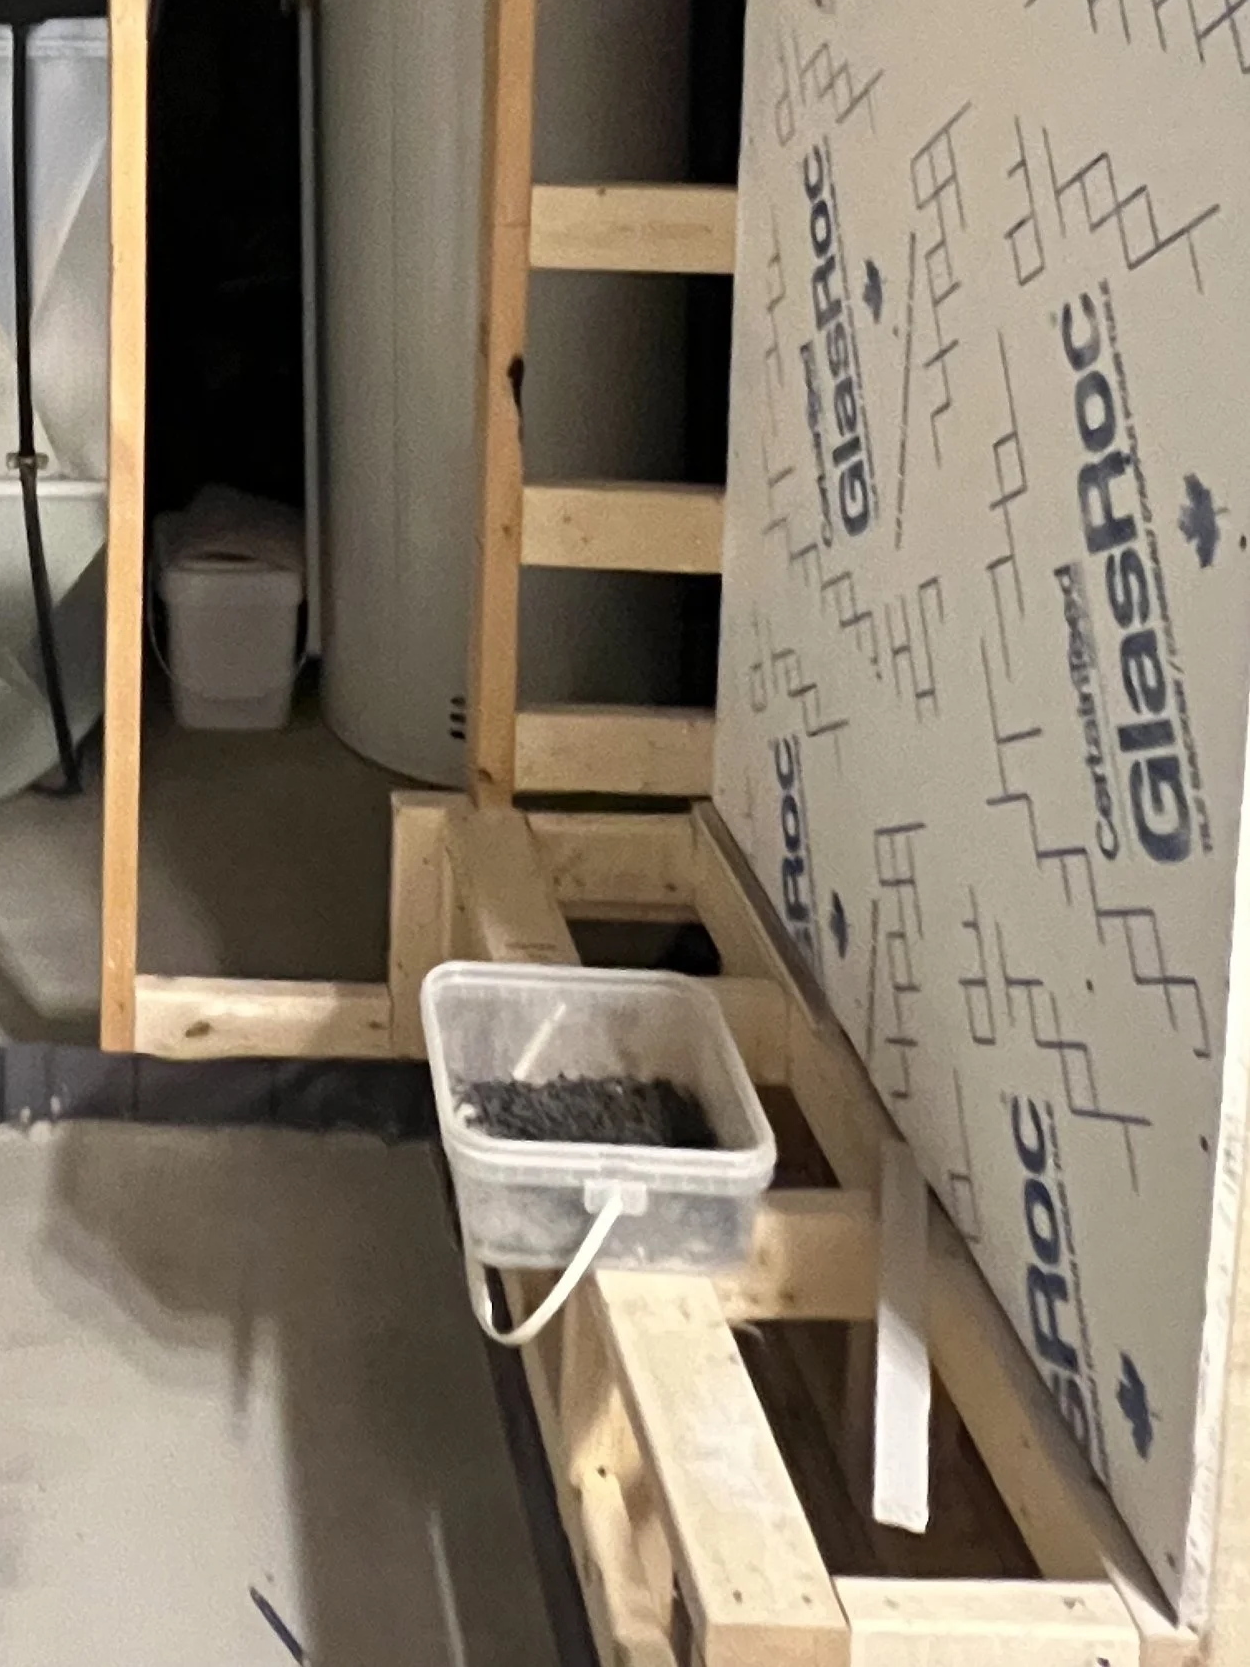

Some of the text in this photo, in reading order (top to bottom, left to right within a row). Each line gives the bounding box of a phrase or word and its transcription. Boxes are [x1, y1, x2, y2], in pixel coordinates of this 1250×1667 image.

[802, 143, 870, 536] GlasRoc
[1054, 563, 1118, 860] CertainTeed
[1061, 291, 1193, 864] GlasRoc
